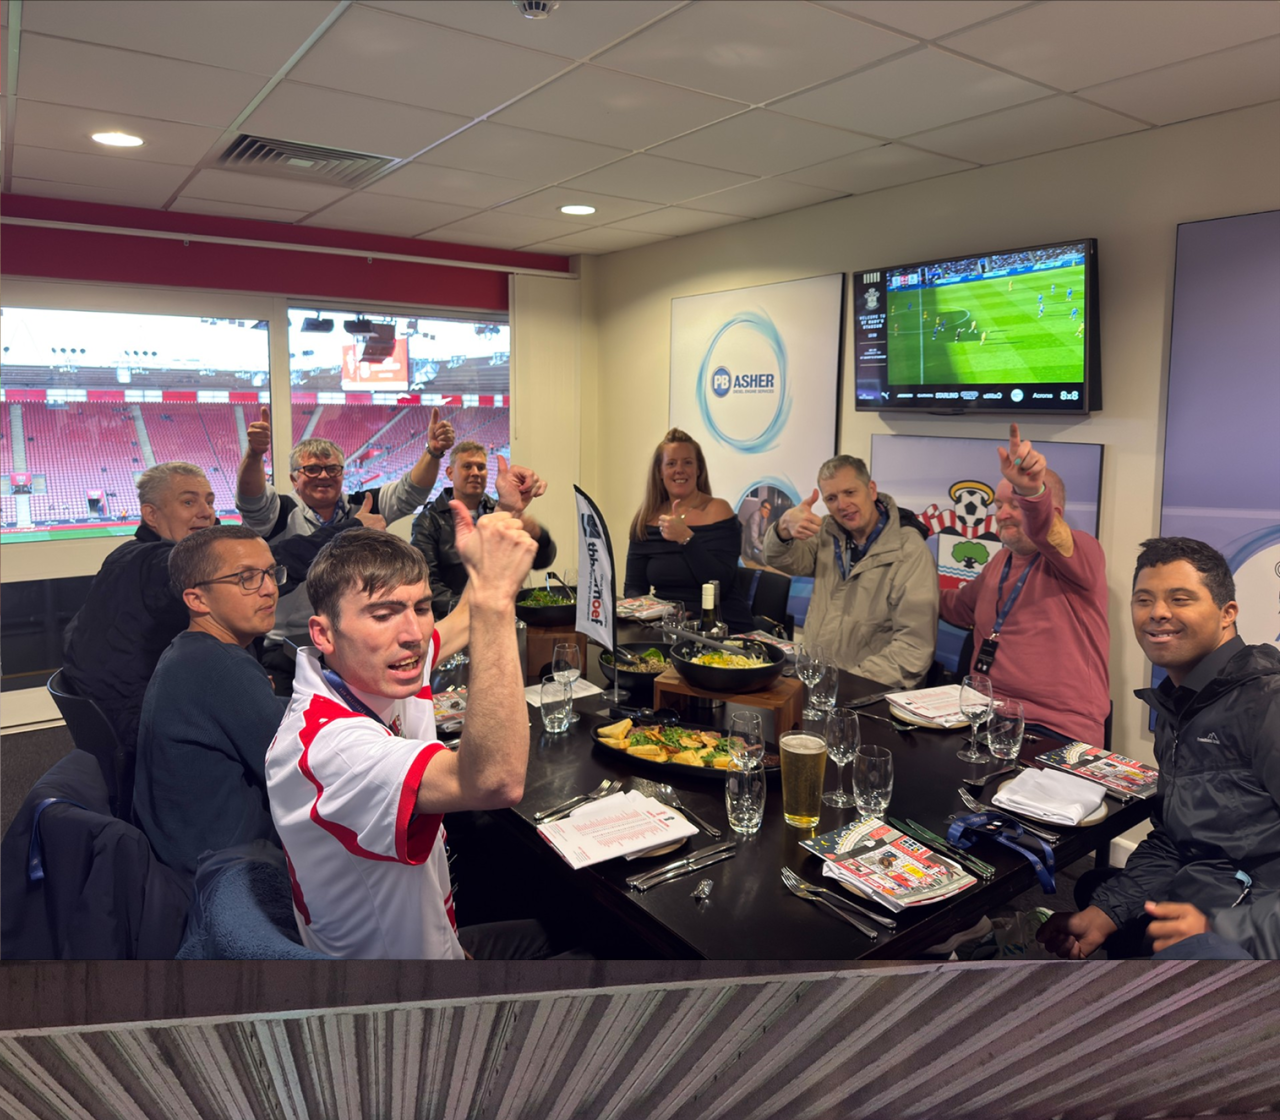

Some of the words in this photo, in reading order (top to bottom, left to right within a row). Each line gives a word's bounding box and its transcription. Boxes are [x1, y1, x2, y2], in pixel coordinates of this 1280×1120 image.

[714, 375, 730, 389] PB
[733, 374, 774, 388] ASHER
[1060, 390, 1079, 400] 8x8
